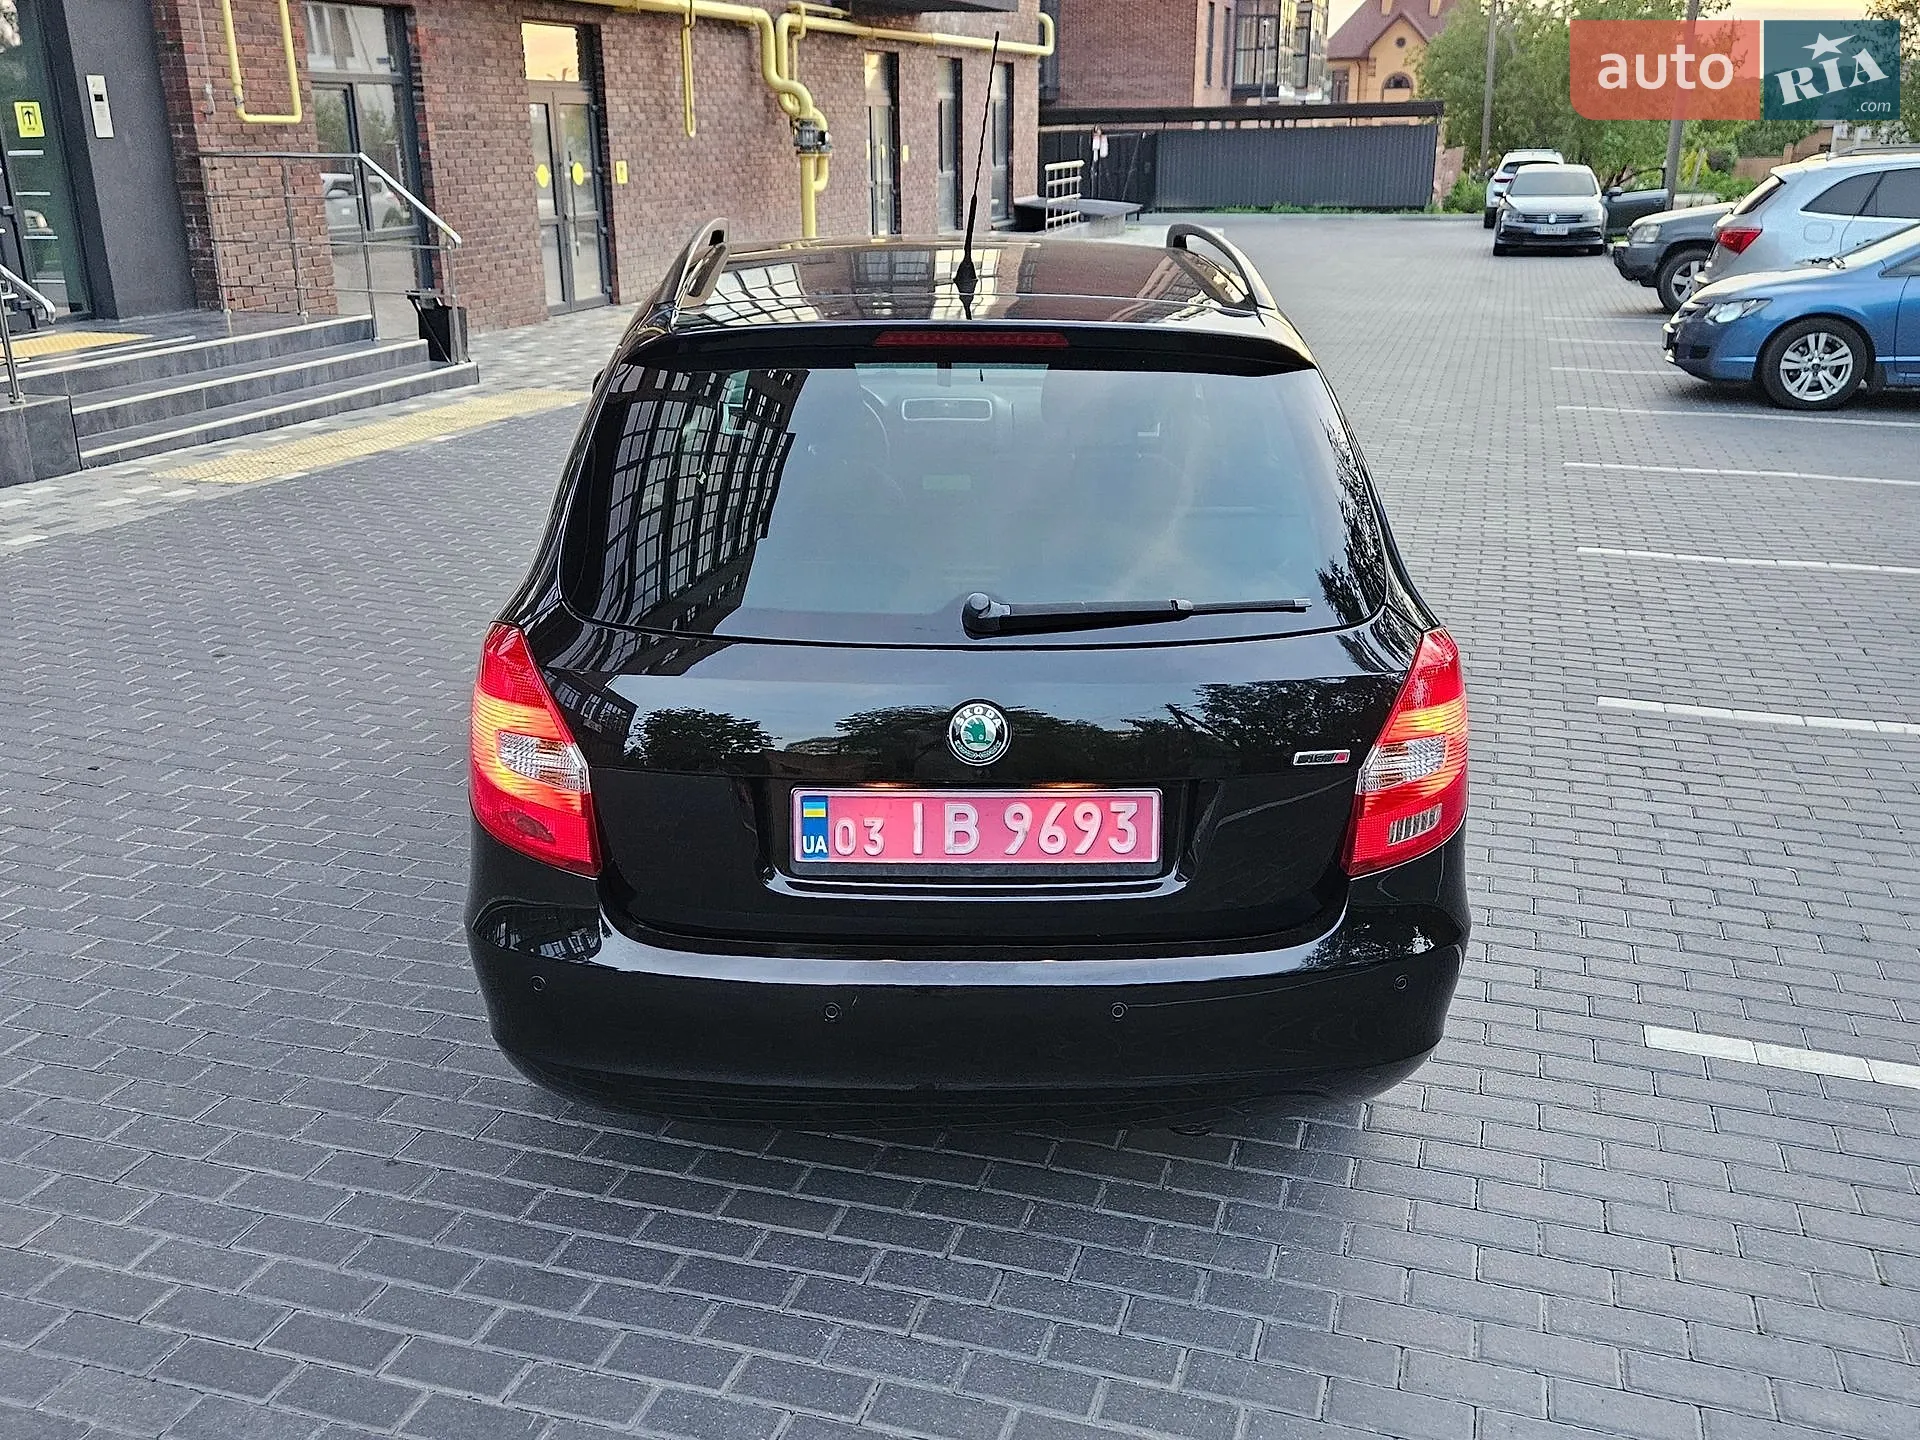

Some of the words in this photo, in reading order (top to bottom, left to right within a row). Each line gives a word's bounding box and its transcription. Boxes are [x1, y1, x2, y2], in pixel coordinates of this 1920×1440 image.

[803, 836, 828, 854] UA
[834, 818, 886, 856] 03
[1003, 802, 1138, 855] 9693
